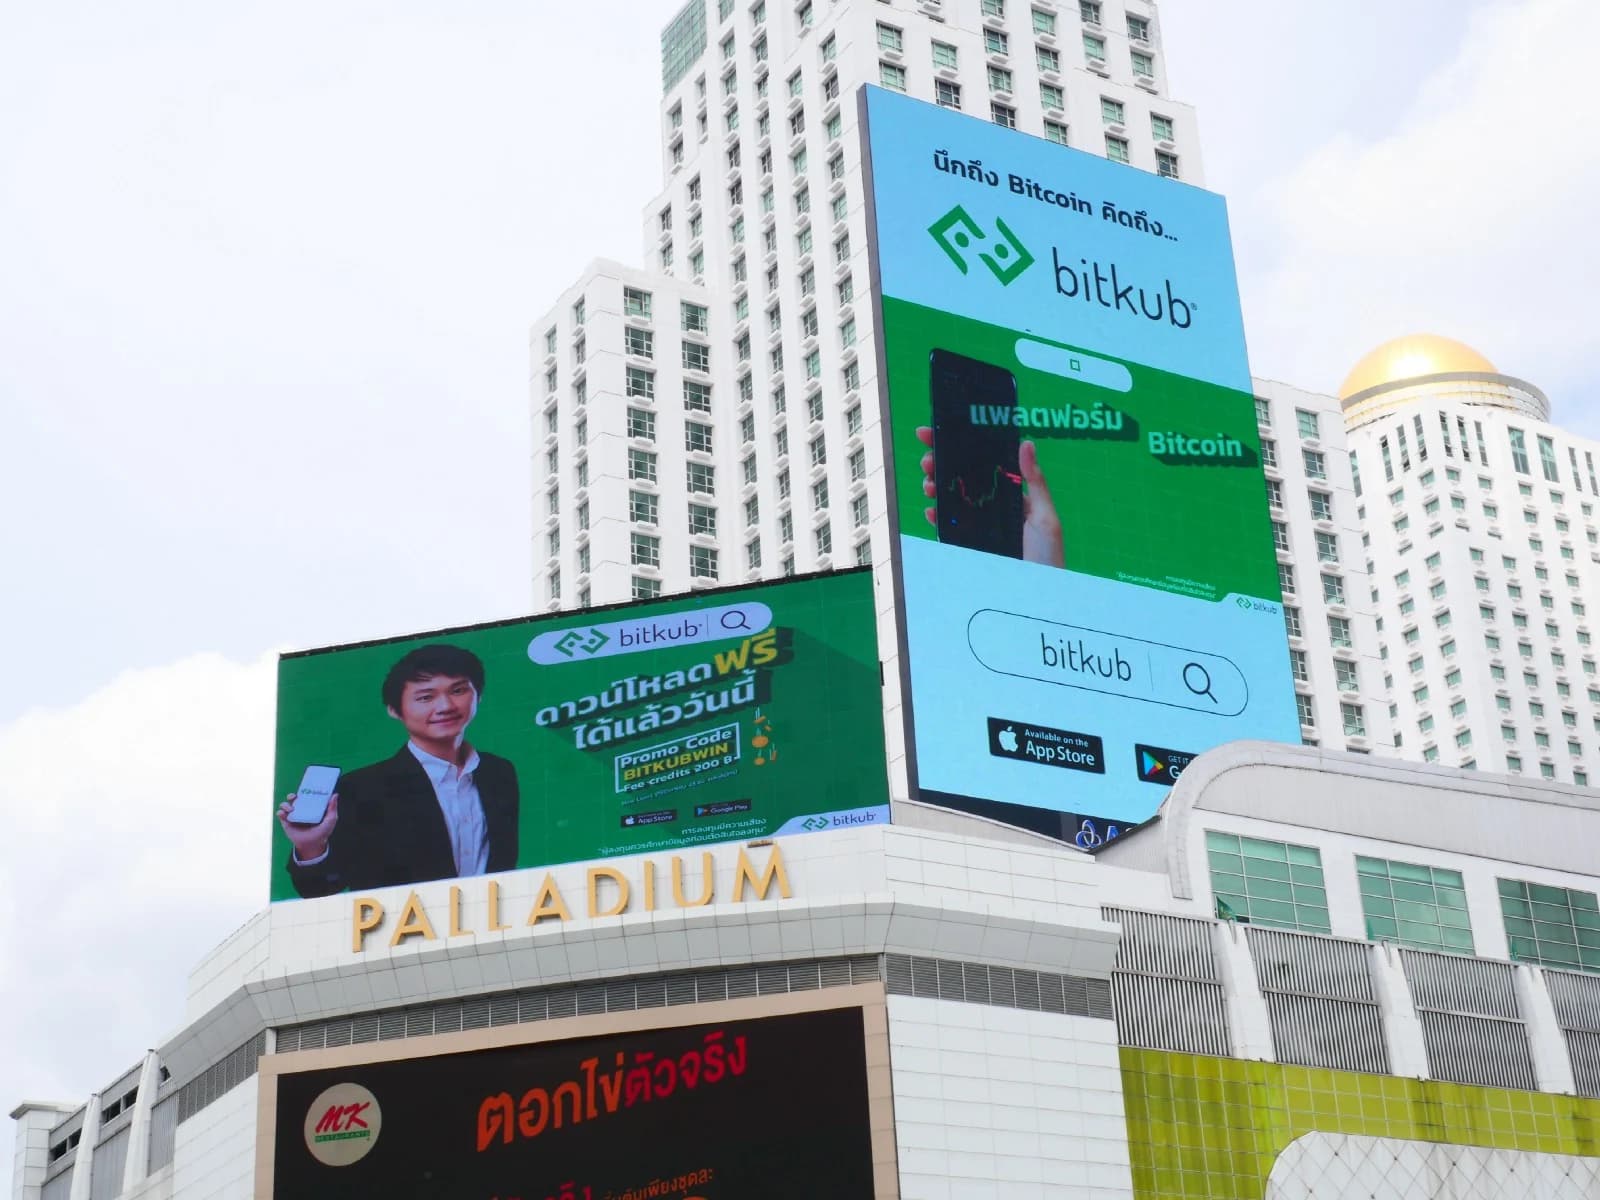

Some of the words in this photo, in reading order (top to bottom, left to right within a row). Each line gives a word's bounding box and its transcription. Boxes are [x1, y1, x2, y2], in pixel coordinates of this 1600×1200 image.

[933, 149, 999, 187] นึกถึง
[1008, 173, 1093, 216] Bitcoin
[970, 402, 1124, 431] แพลตฟอร์ม
[1147, 431, 1243, 458] Bitcoin
[1040, 632, 1132, 682] bitkub
[572, 669, 757, 751] ได้แล้ววันนี้
[621, 745, 678, 769] Promo
[686, 730, 732, 750] Code
[1025, 729, 1061, 743] Available
[1063, 737, 1074, 745] on
[1075, 738, 1089, 748] the
[1025, 740, 1055, 762] App
[1058, 746, 1095, 766] Store
[623, 742, 728, 781] BITKUBWIN
[624, 780, 645, 792] Fee
[648, 769, 690, 786] credits
[638, 817, 652, 825] App
[653, 813, 673, 823] Store
[351, 842, 793, 953] PALLADIUM
[476, 1030, 747, 1153] ตอกไข่ตัวจริง
[315, 1101, 371, 1134] MK
